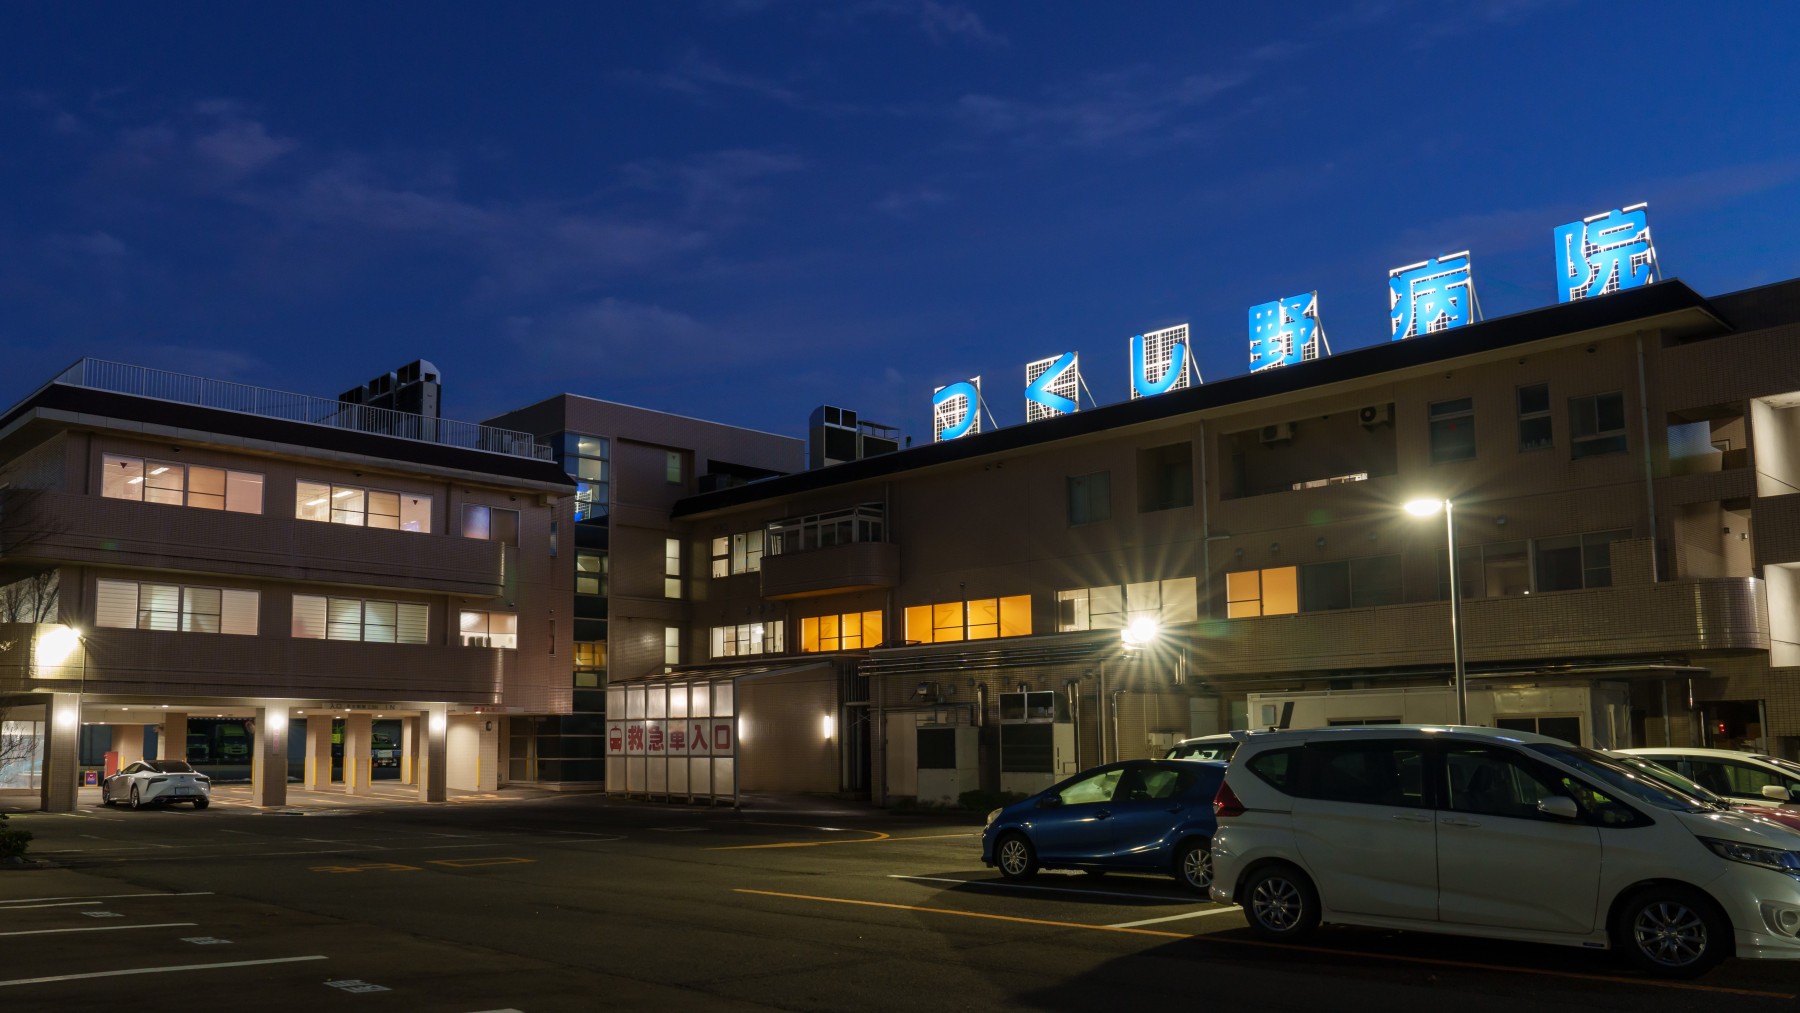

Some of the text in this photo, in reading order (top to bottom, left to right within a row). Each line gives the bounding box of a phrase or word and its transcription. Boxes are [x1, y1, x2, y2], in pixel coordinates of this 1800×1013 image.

[932, 209, 1650, 440] つくし野病院
[627, 724, 731, 752] 救急車入口
